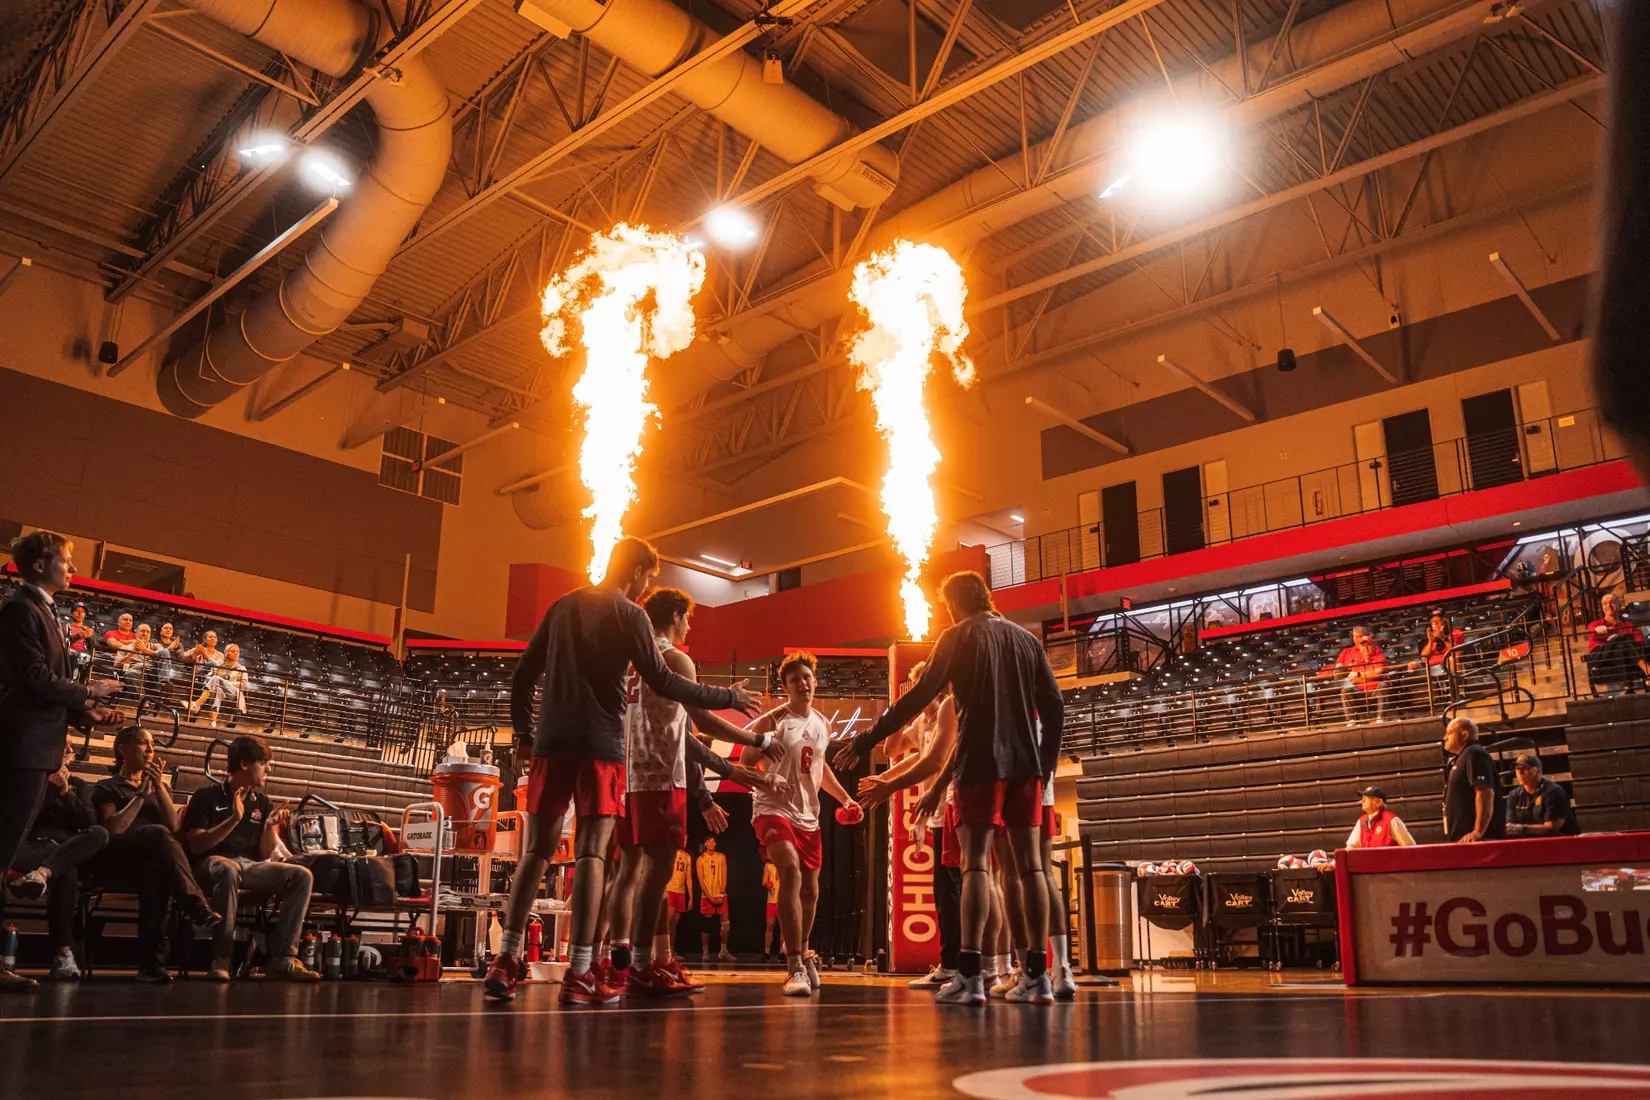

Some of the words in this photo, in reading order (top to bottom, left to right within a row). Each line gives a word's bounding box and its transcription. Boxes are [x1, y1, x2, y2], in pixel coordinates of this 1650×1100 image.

[1506, 648, 1519, 657] 10
[800, 746, 814, 774] 6
[473, 785, 495, 809] G
[407, 832, 433, 841] GATORADE
[675, 860, 685, 873] 13
[902, 845, 937, 944] OHIO
[1287, 895, 1310, 903] CART
[1389, 894, 1650, 957] #GoBu
